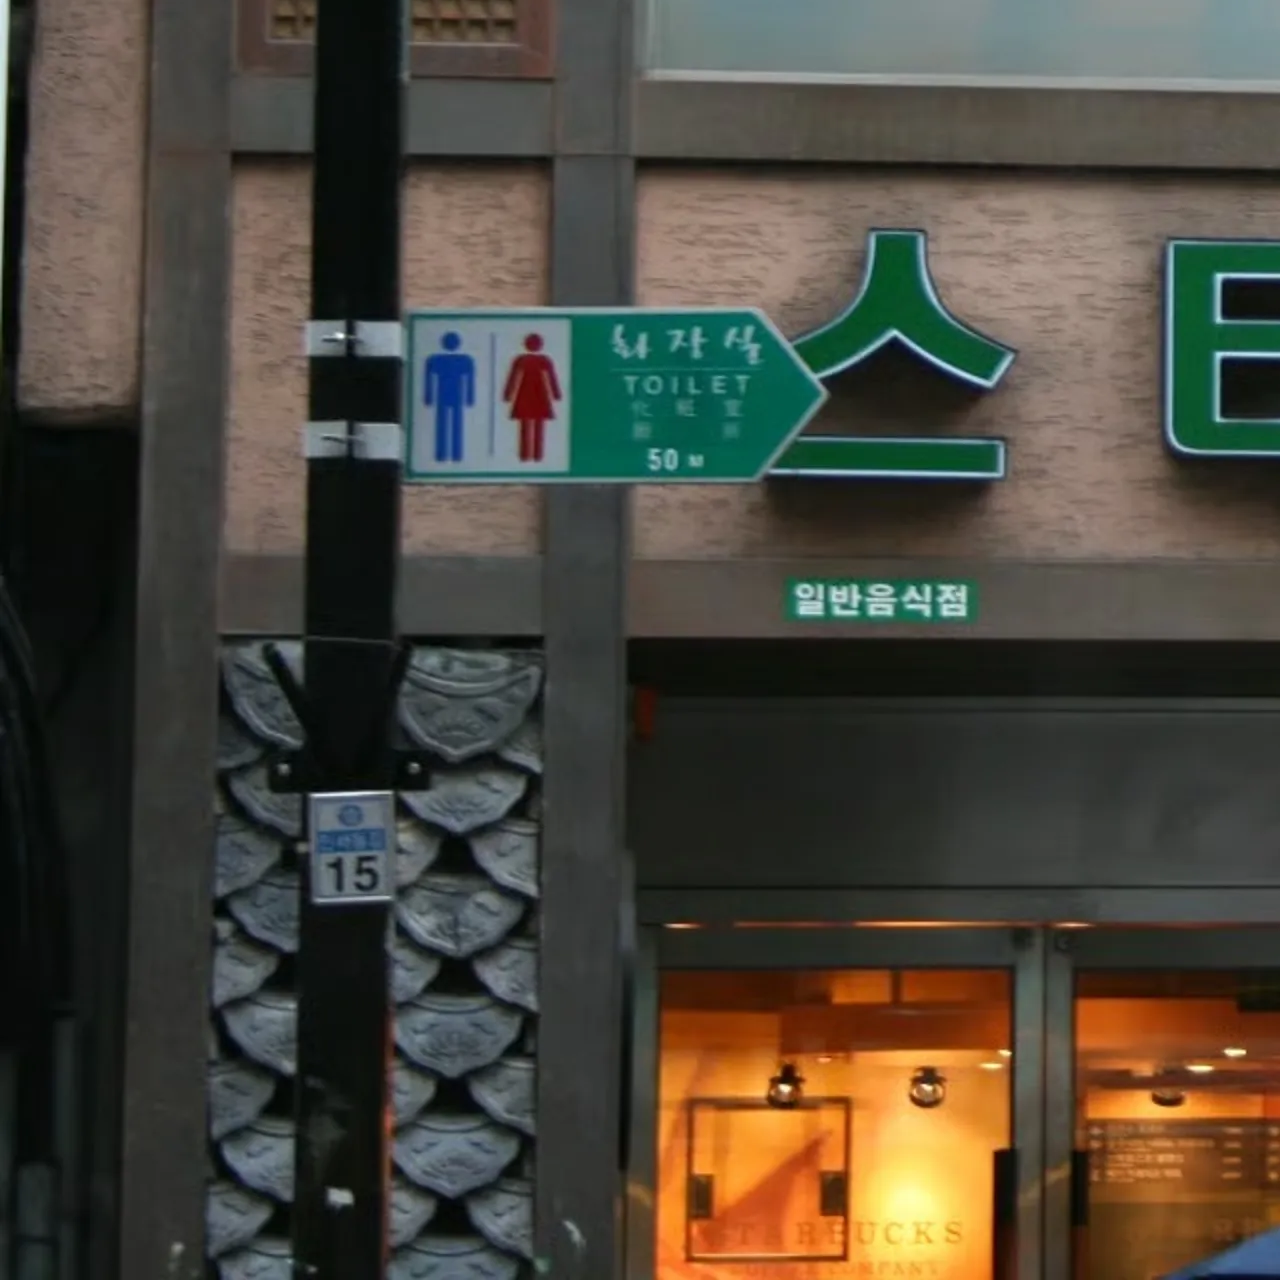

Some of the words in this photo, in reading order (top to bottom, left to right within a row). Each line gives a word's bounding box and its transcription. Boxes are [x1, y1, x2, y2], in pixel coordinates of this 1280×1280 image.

[609, 323, 765, 366] 화장실
[622, 374, 751, 397] TOILET
[646, 447, 679, 472] 50
[794, 583, 969, 619] 일반음식점
[325, 854, 380, 893] 15
